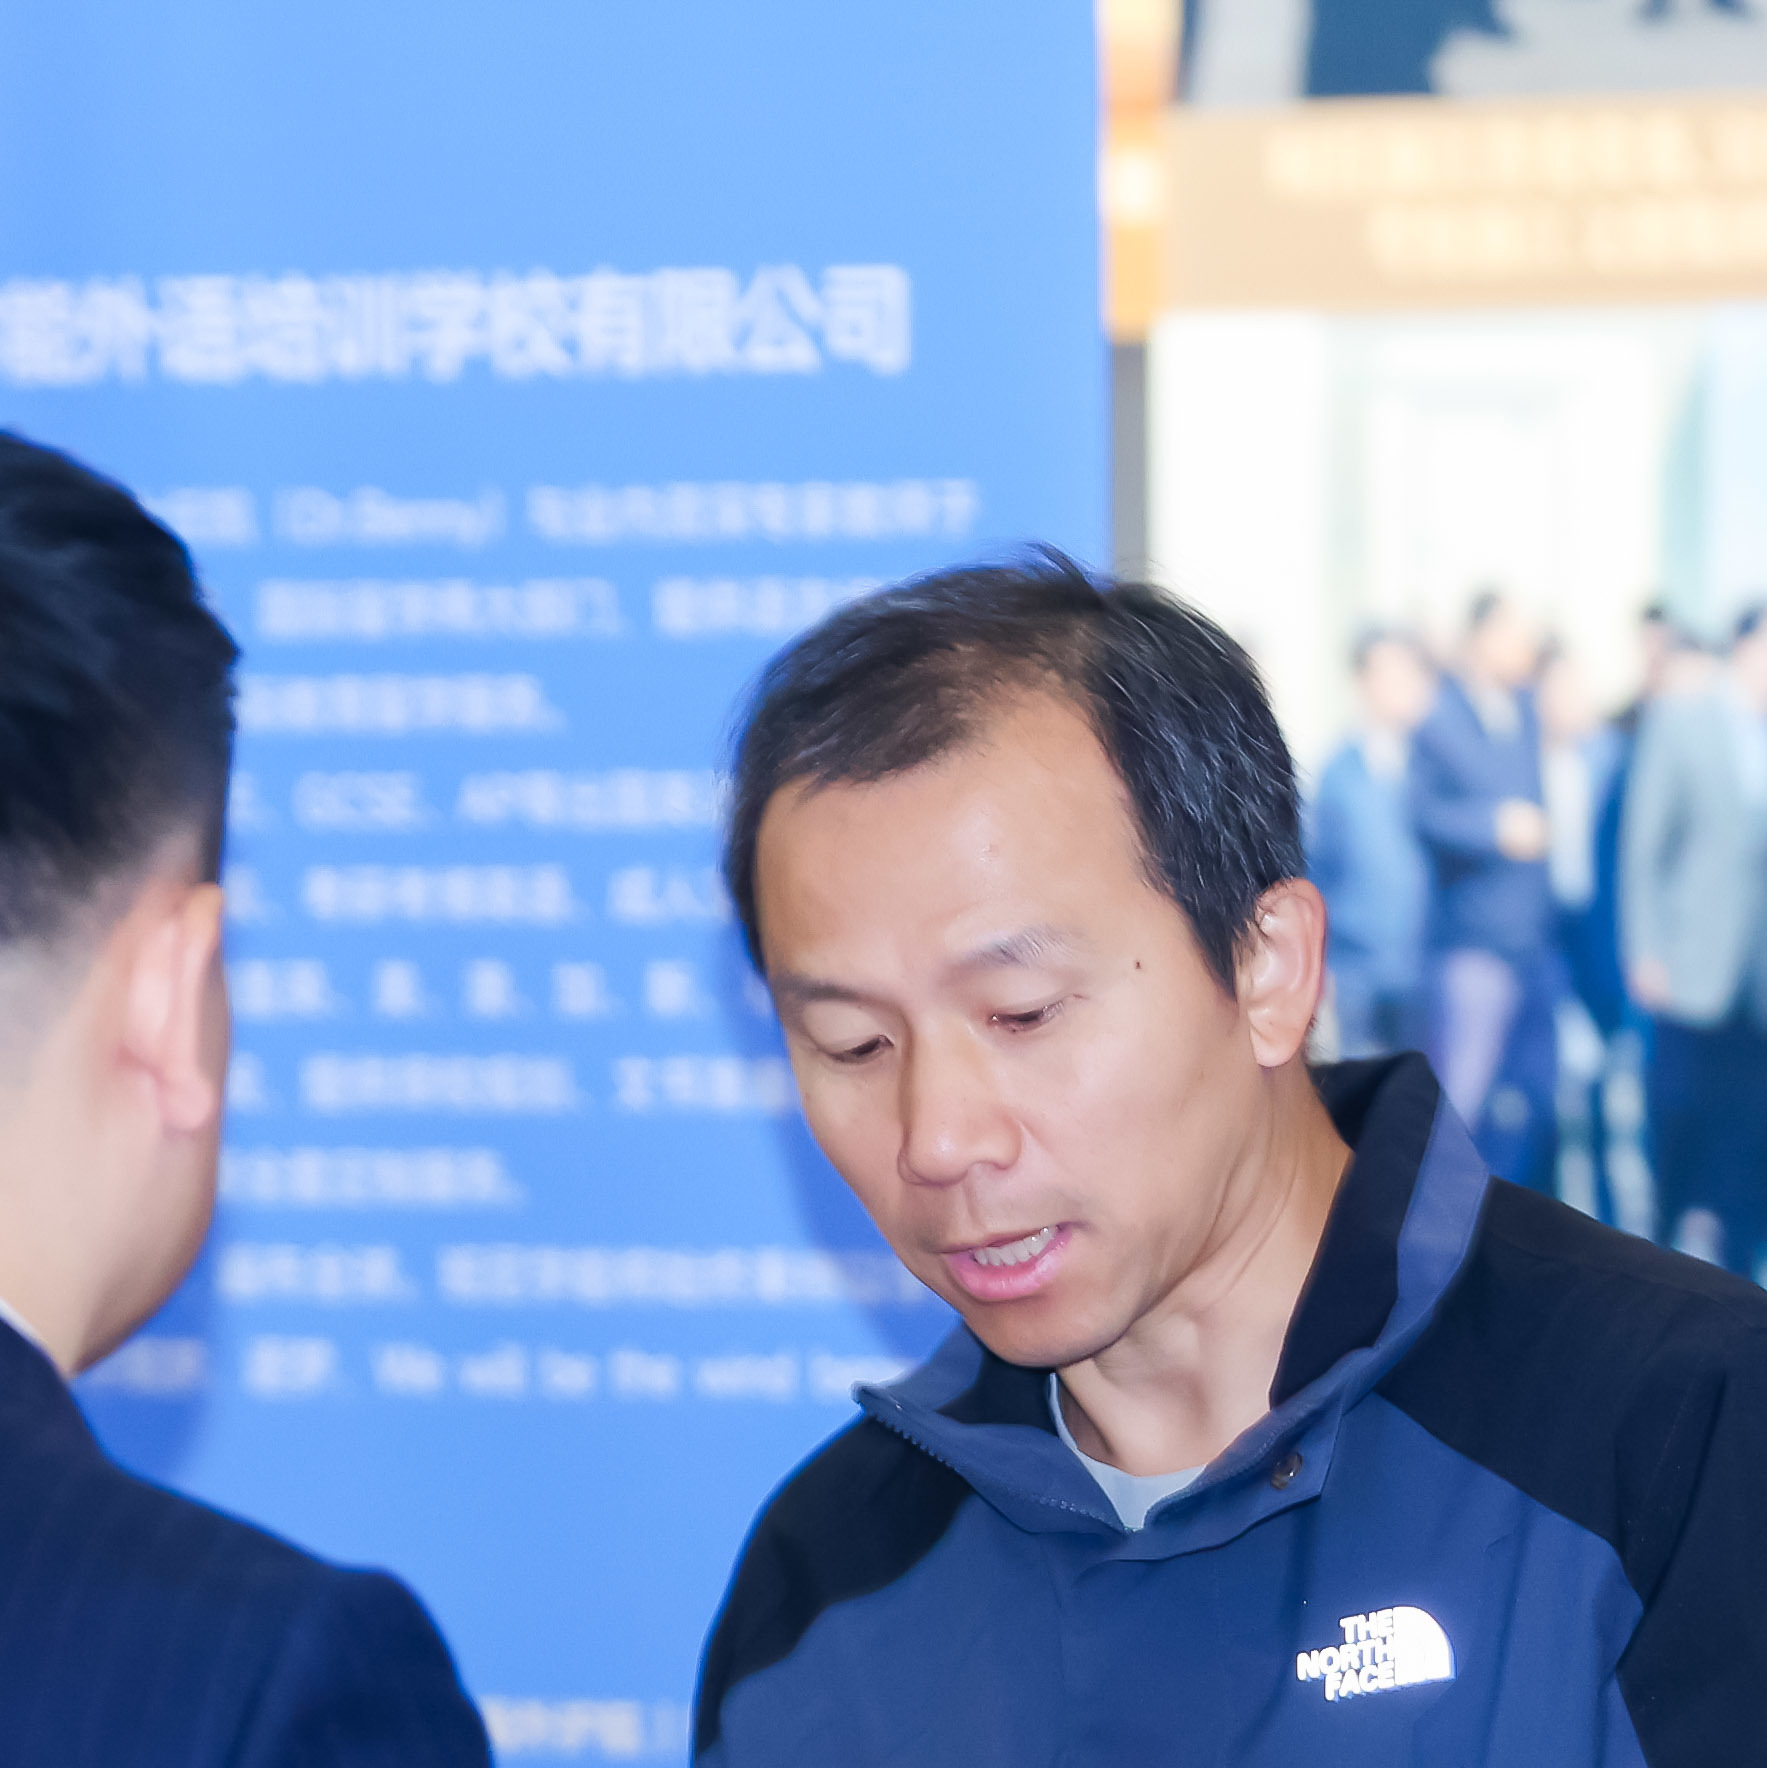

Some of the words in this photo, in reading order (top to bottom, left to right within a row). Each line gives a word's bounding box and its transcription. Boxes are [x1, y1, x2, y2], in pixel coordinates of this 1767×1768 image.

[1338, 1608, 1396, 1645] THE
[1296, 1633, 1397, 1682] NORTH
[1324, 1660, 1397, 1701] FACE
